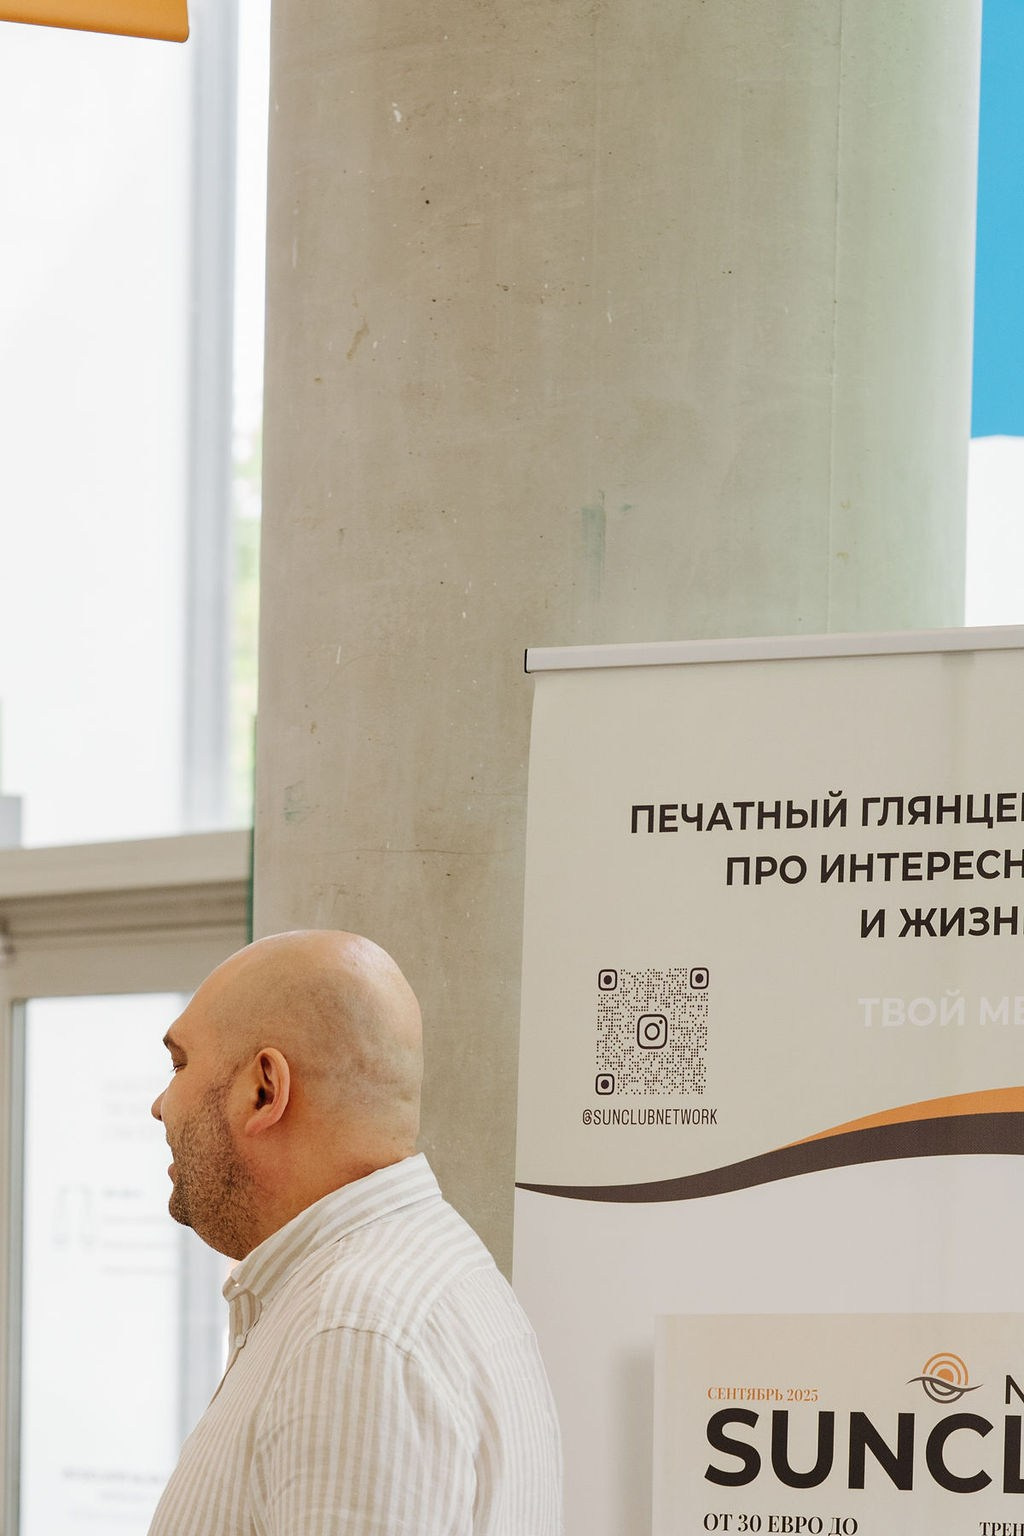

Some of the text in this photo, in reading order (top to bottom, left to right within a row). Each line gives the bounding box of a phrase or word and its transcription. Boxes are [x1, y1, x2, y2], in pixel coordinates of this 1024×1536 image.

[630, 790, 1024, 834] ПЕЧАТНЫЙ ГЛЯНЦЕ
[725, 849, 1024, 886] ПРО ИНТЕРЕСН
[860, 906, 1024, 938] И ЖИЗН
[858, 989, 965, 1028] ТВОЙ
[582, 1108, 718, 1125] @SUNCLUBNETWORK
[707, 1386, 819, 1402] СЕНТЯБРЬ 2025
[703, 1513, 732, 1532] ОТ
[737, 1514, 762, 1533] 30
[766, 1516, 823, 1535] ЕВРО
